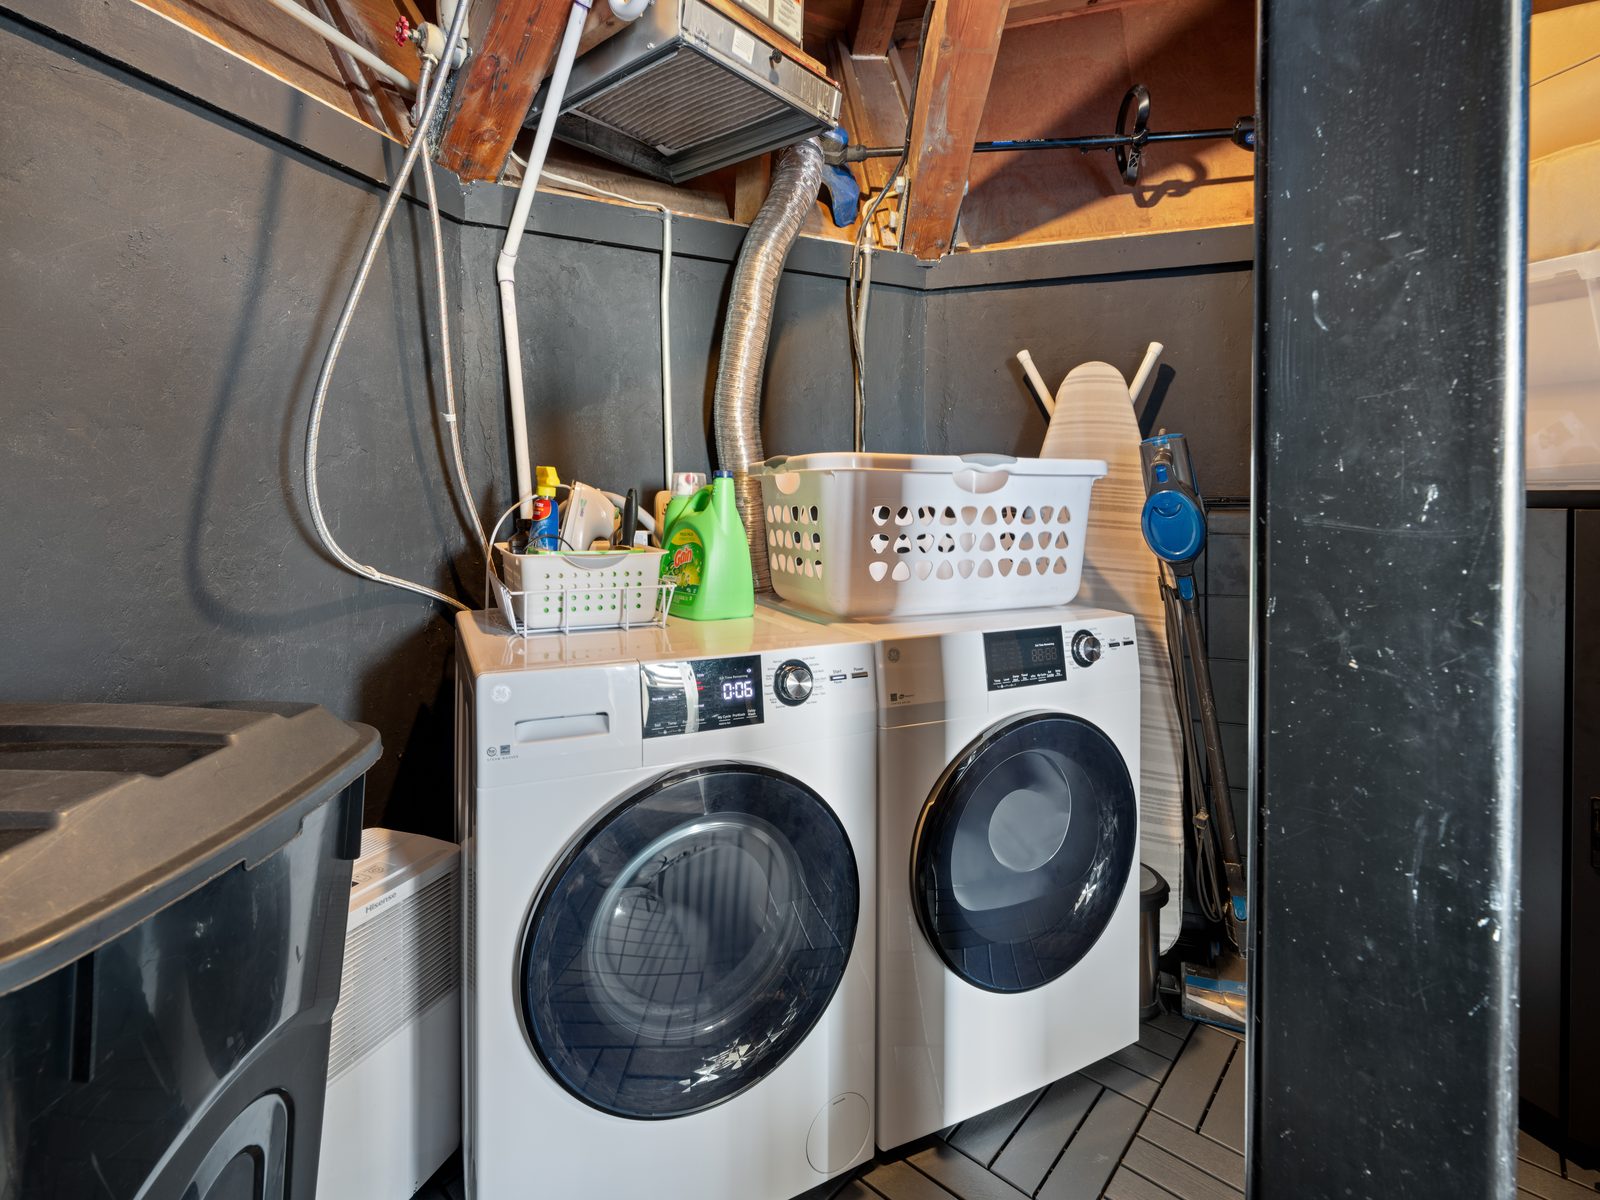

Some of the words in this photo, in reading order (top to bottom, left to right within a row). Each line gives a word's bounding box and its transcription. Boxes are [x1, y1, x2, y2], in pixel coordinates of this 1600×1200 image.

[674, 547, 693, 568] Gain
[722, 680, 753, 700] 0:06
[365, 892, 397, 914] Hisense
